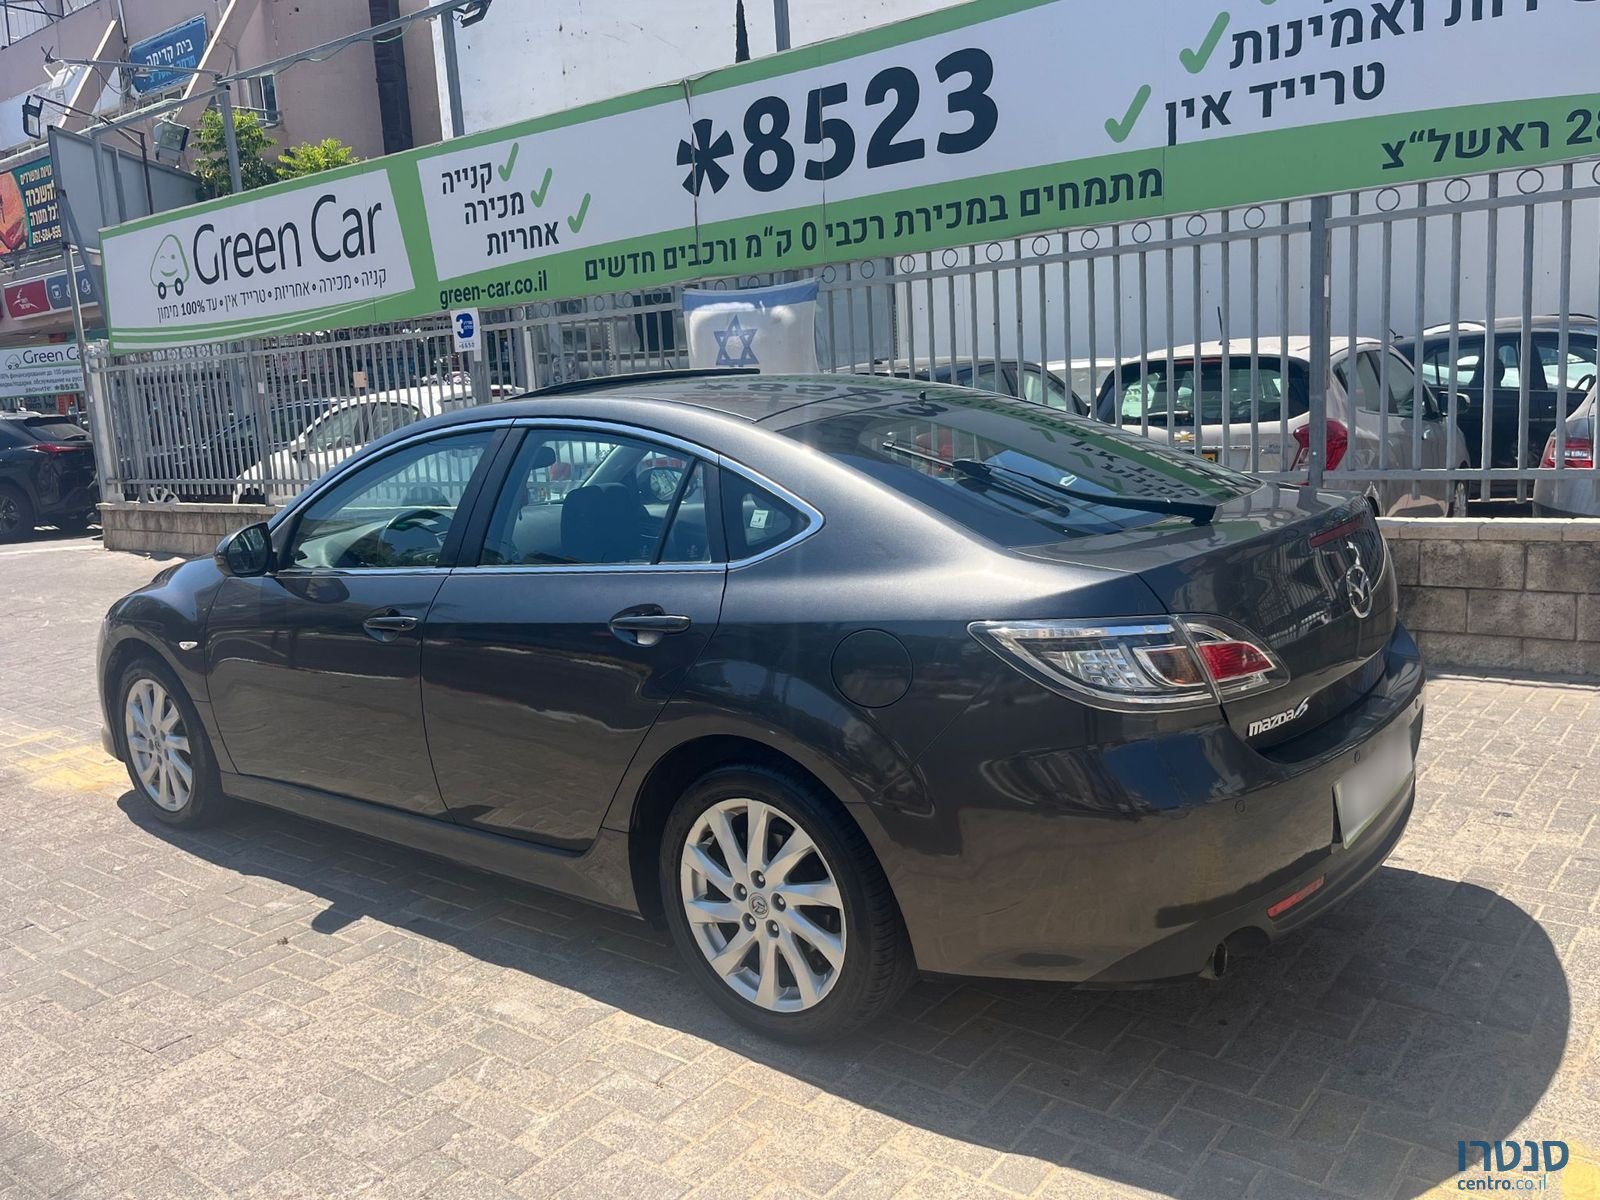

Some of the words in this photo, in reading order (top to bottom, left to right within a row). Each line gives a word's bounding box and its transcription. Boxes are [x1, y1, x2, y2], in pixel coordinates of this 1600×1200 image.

[176, 39, 193, 56] בית
[1229, 0, 1425, 69] ואמינות
[1249, 61, 1386, 118] טרייד
[1165, 90, 1233, 146] אין
[1566, 109, 1600, 146] 2
[1381, 120, 1549, 170] ראשל"צ
[441, 162, 493, 194] קנייה
[1020, 168, 1162, 217] מתמחים
[464, 192, 525, 225] מכירה
[894, 194, 1008, 237] במכירת
[193, 221, 302, 285] Green
[311, 194, 382, 263] Car
[487, 221, 559, 257] אחריות
[745, 226, 792, 258] ק"מ
[801, 221, 817, 251] 0
[825, 214, 885, 247] רכבי
[585, 250, 656, 281] חדשים
[663, 238, 737, 271] ורכבים
[274, 281, 310, 301] אחריות
[319, 274, 351, 293] מכירה
[361, 268, 387, 290] קניה
[440, 270, 548, 310] green-car.co.il
[181, 299, 205, 316] 100%
[206, 297, 218, 312] עד
[225, 293, 238, 312] אין
[240, 287, 266, 305] טרייד
[157, 302, 179, 323] מימון
[22, 350, 64, 364] Green
